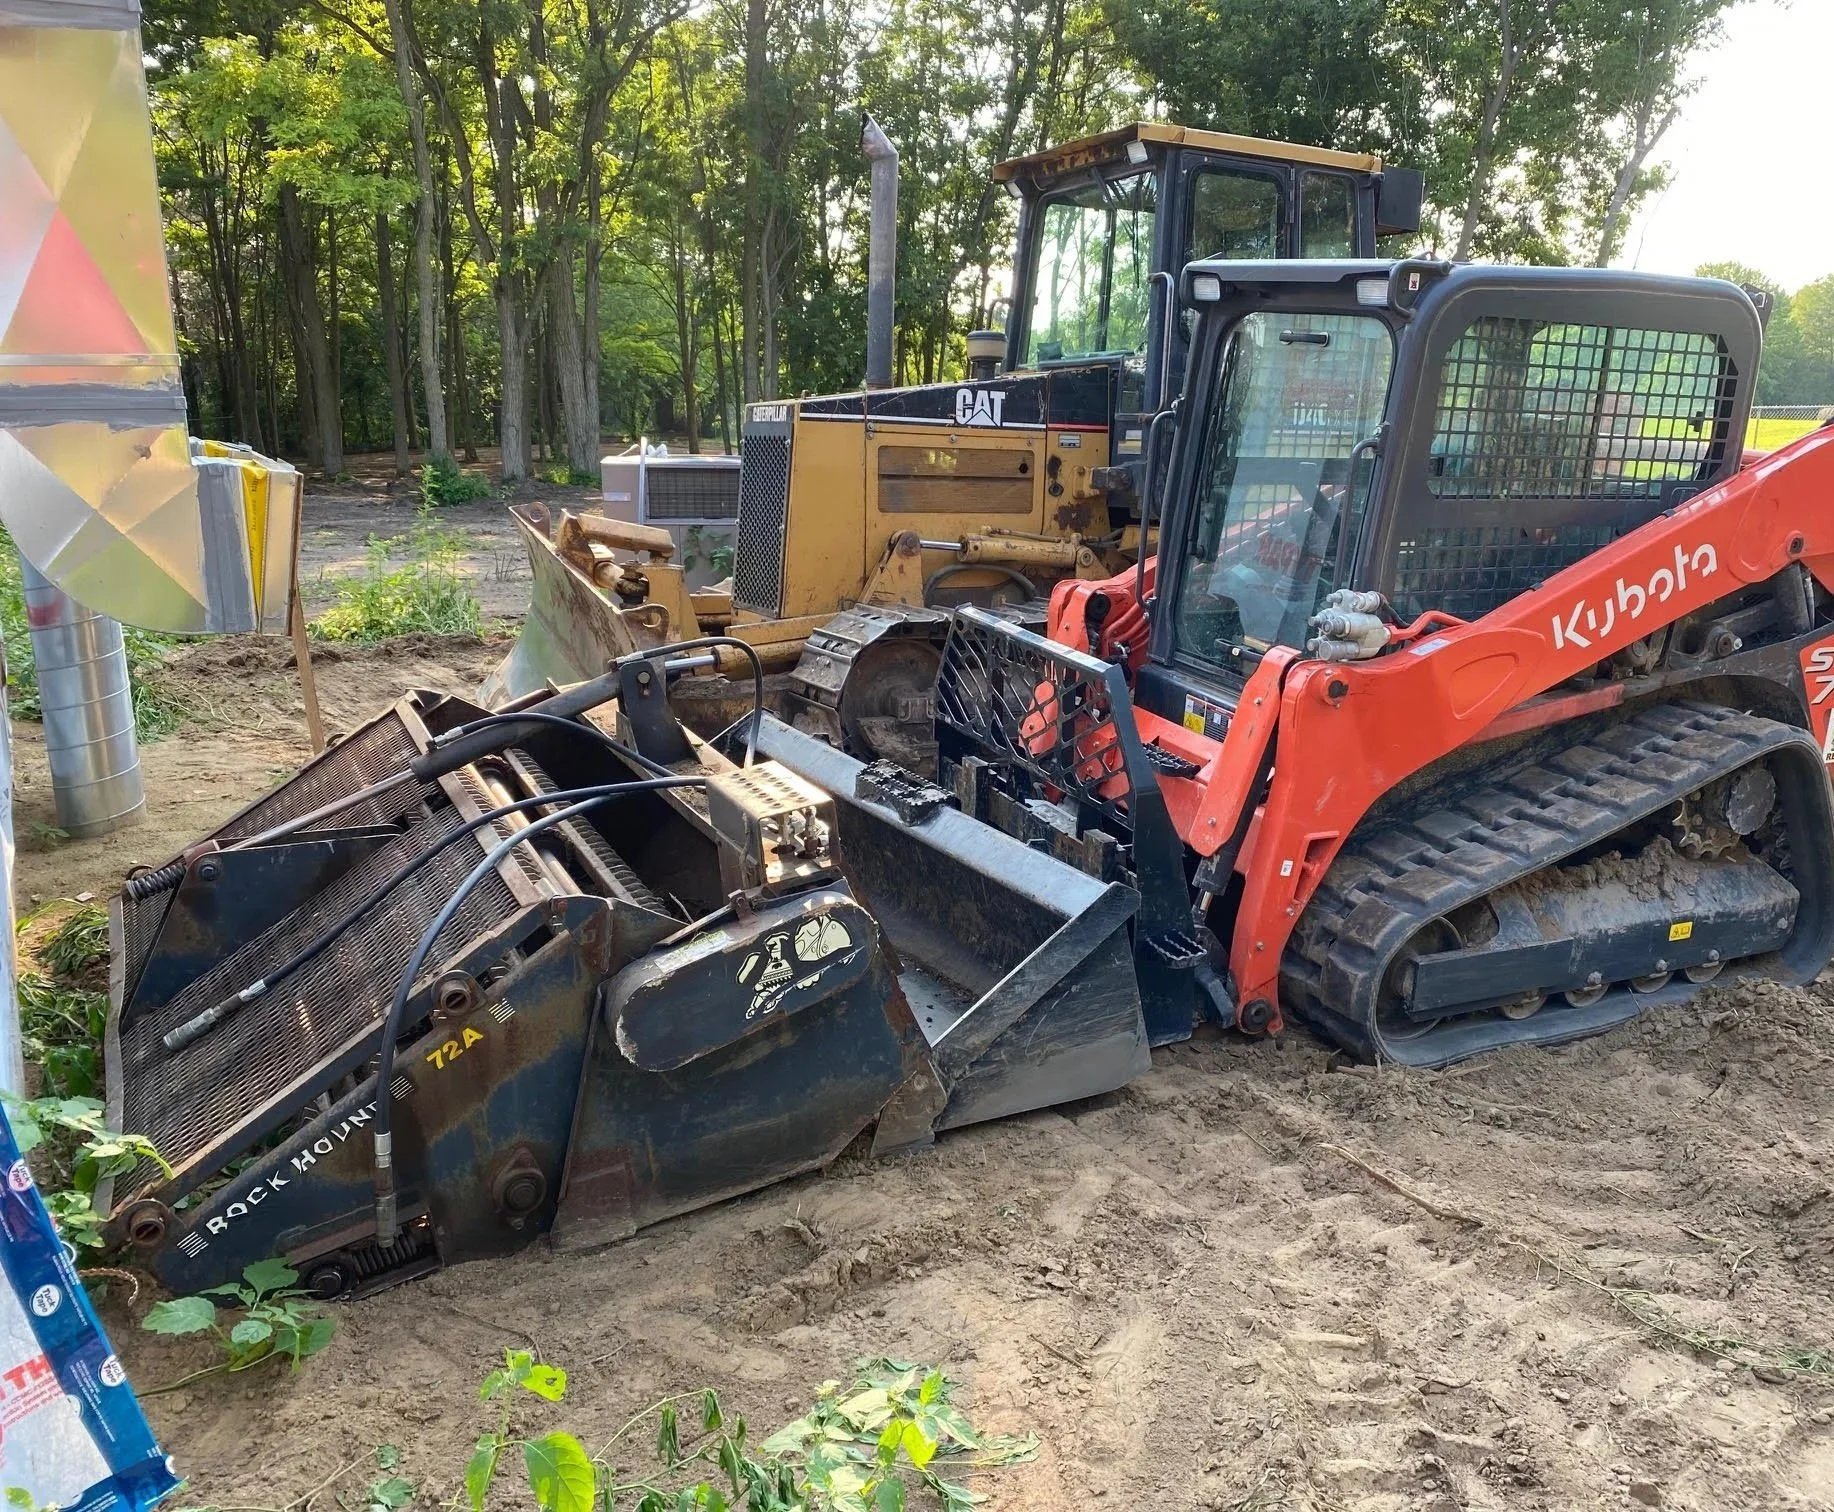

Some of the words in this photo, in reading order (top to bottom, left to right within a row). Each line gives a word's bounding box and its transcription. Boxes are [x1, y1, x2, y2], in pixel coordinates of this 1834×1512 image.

[753, 405, 787, 422] CATERPILLAR
[955, 388, 1006, 427] CAT
[1552, 543, 1718, 650] Kubota
[426, 1027, 484, 1070] 72A
[205, 1170, 291, 1235] ROCK
[290, 1100, 377, 1175] HOUN
[42, 1287, 56, 1308] Tuck
